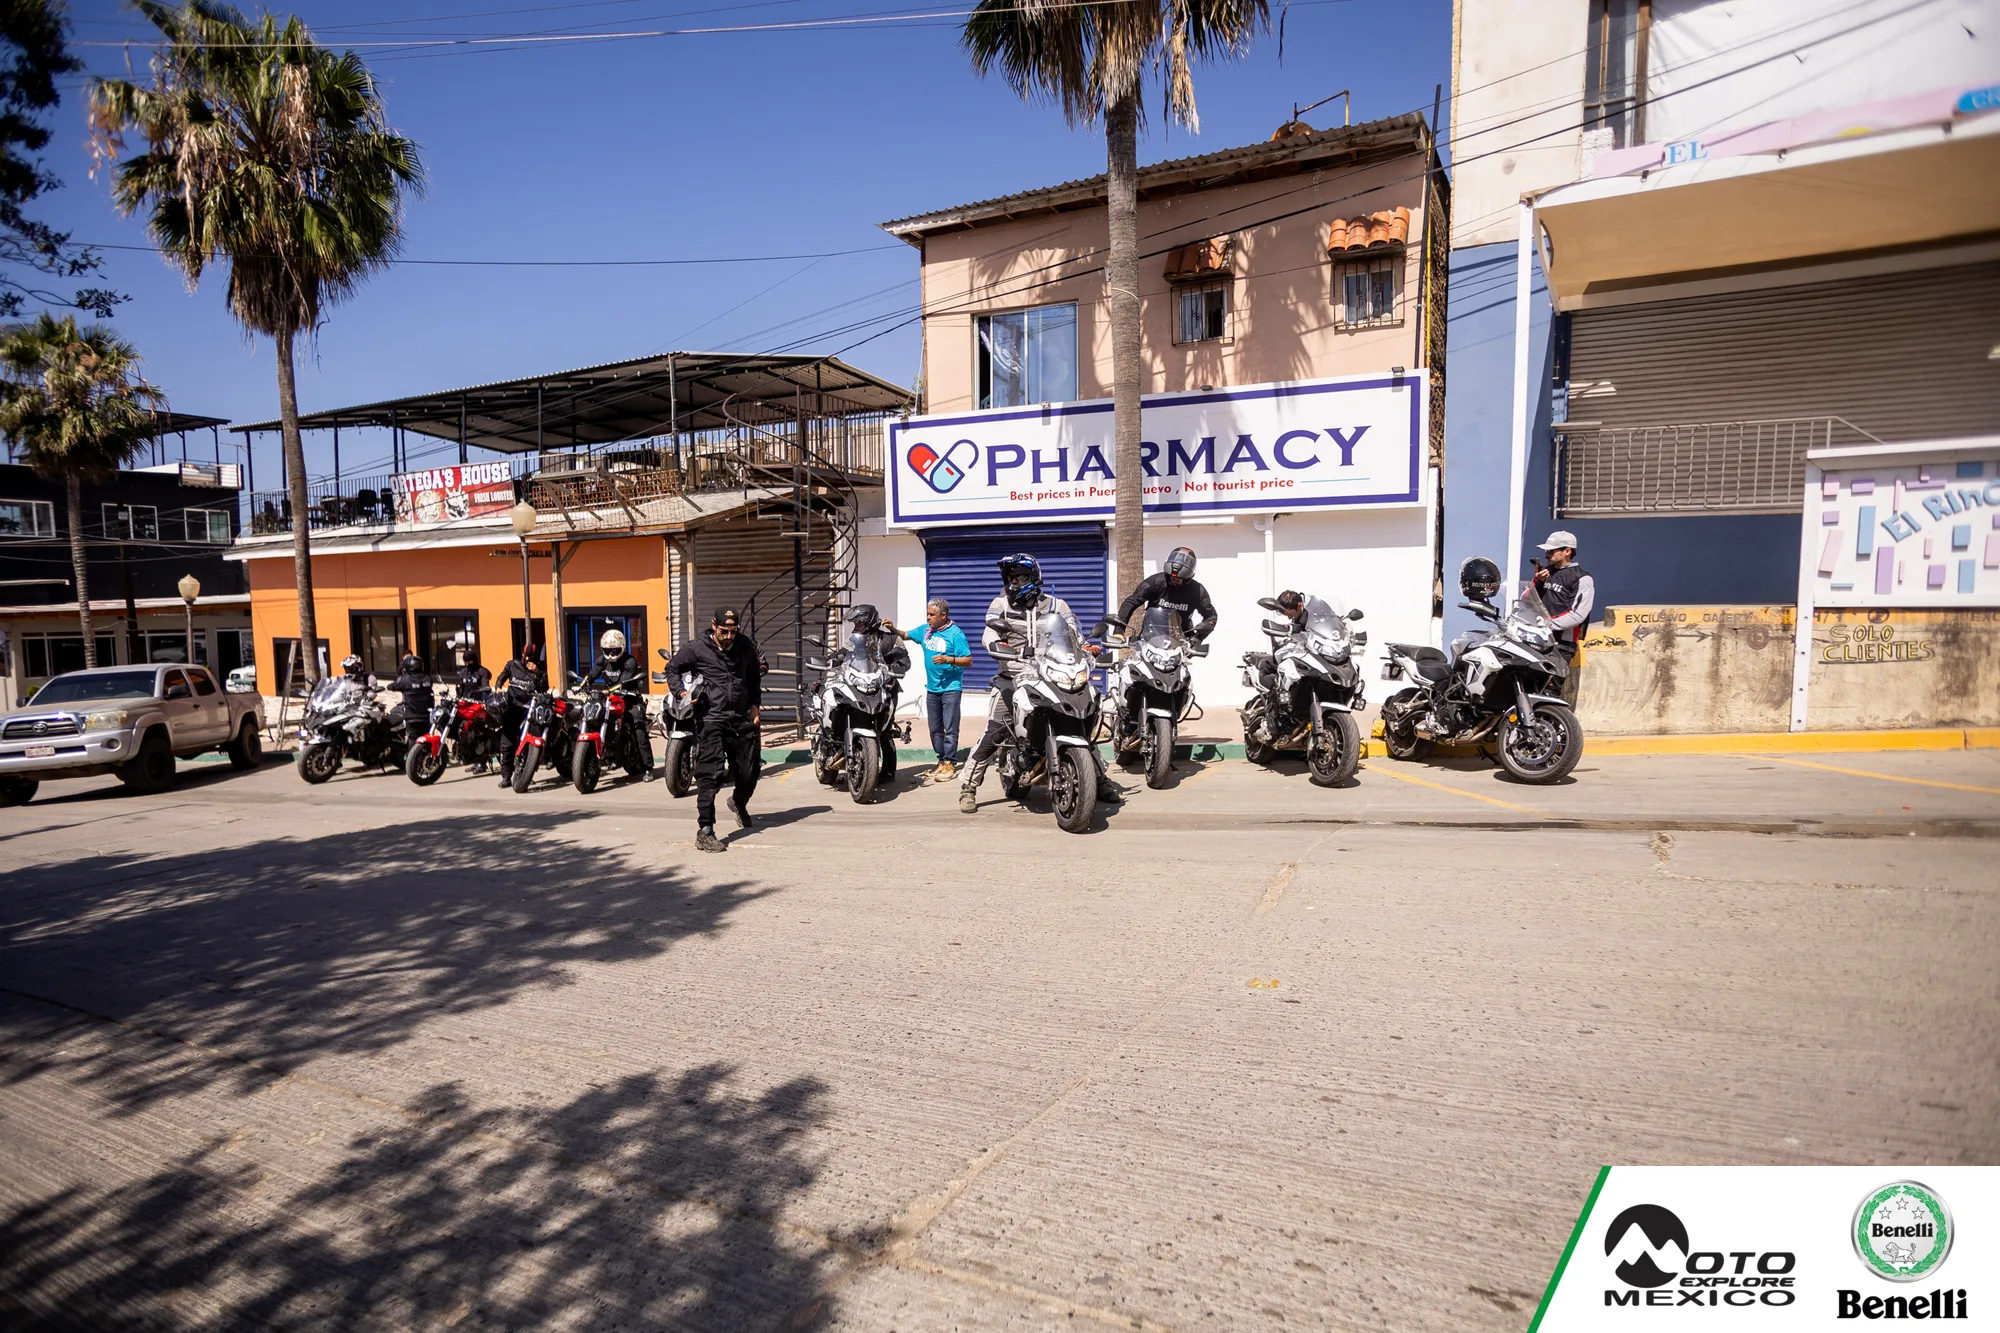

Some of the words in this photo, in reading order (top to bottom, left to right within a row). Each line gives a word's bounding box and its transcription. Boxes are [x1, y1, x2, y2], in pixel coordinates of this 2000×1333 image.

[1668, 141, 1709, 166] EL
[986, 425, 1371, 487] PHARMACY
[390, 468, 454, 493] ORTEGA'S
[460, 462, 511, 486] HOUSE
[1010, 491, 1033, 501] Best
[1037, 489, 1070, 501] prices
[1074, 488, 1085, 497] in
[1089, 486, 1116, 497] Puer
[1143, 485, 1172, 494] uevo
[1184, 481, 1208, 492] Not
[1213, 479, 1255, 491] tourist
[1260, 477, 1294, 491] price
[1158, 598, 1189, 611] Benelli
[1536, 615, 1546, 626] 2
[1830, 625, 1894, 644] SOLO
[1823, 641, 1935, 662] CLIENTES
